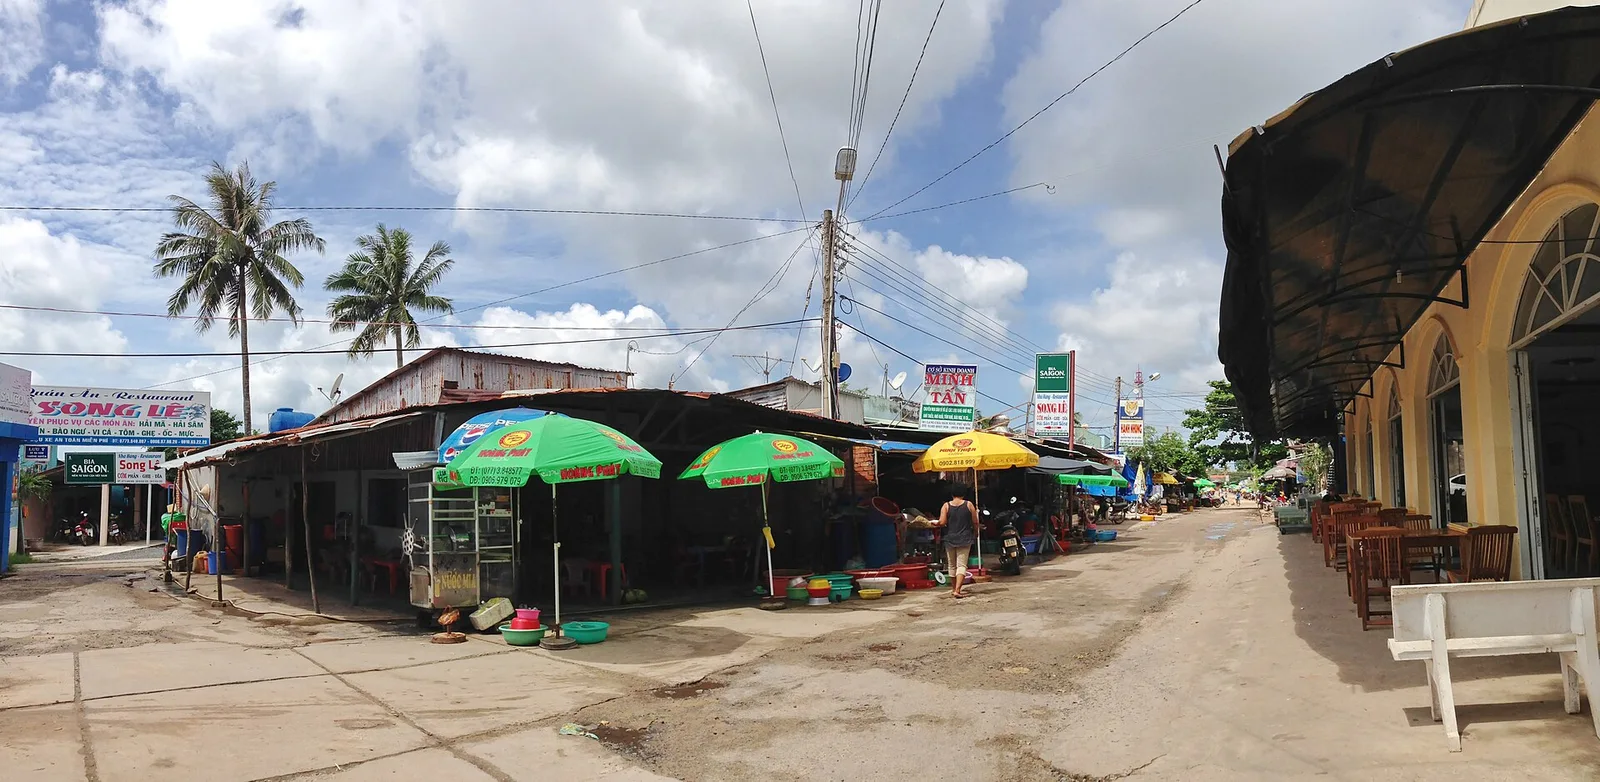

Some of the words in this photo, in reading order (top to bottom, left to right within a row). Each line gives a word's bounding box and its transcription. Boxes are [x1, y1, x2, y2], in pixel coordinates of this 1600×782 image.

[925, 373, 974, 387] MINH
[112, 391, 195, 401] Restaurant
[930, 386, 967, 405] TẤN
[38, 401, 141, 418] SONG
[147, 402, 187, 419] LÊ
[1037, 403, 1057, 413] SONG
[47, 419, 69, 427] PHỤC
[71, 419, 82, 428] VỤ
[84, 419, 101, 427] CÁC
[103, 418, 121, 428] MÓN
[138, 420, 152, 428] HẢI
[173, 421, 186, 429] HẢI
[494, 419, 522, 427] PE
[119, 428, 135, 436] TÔM
[162, 428, 173, 437] ỐC
[179, 430, 195, 438] MỰC
[507, 447, 533, 457] PHÁT
[119, 459, 146, 473] Song
[964, 458, 975, 466] 999
[71, 464, 108, 474] SAIGON
[560, 465, 595, 480] HOÀNG
[596, 462, 622, 476] PHÁT
[721, 476, 745, 486] HOÀNG
[746, 473, 766, 484] PHÁT
[441, 568, 462, 590] NƯỚC
[462, 567, 477, 589] MÍA
